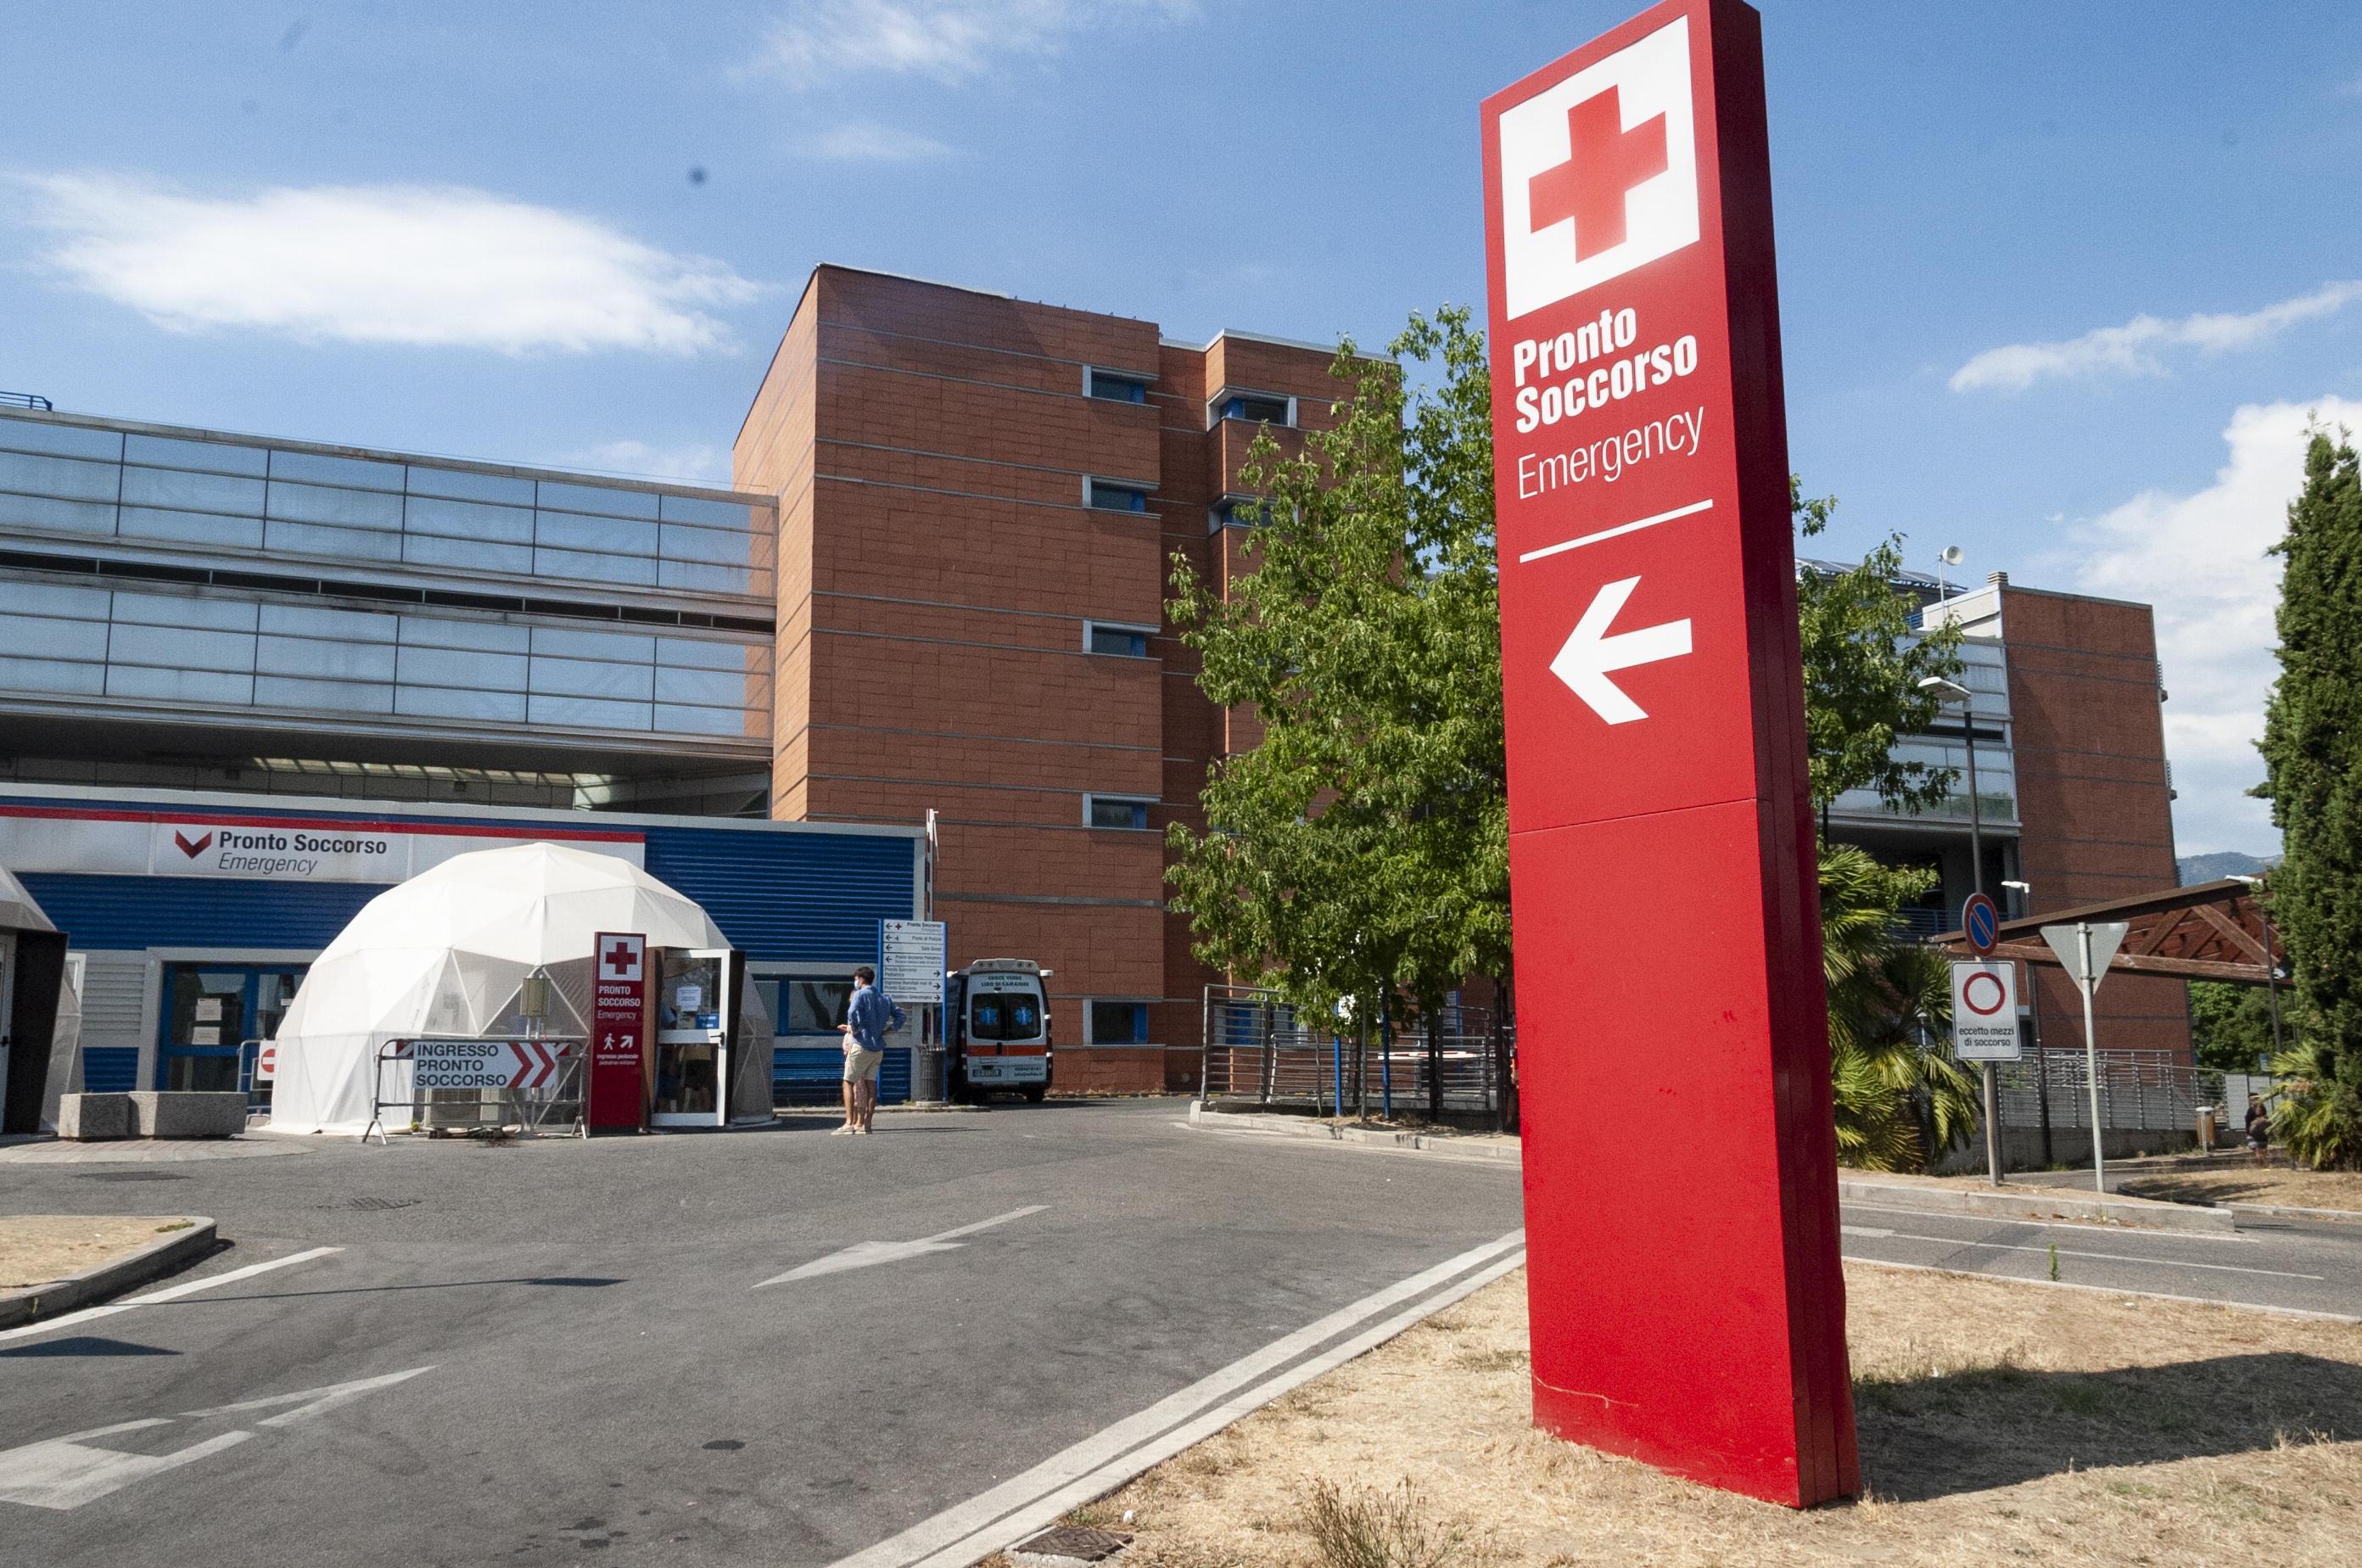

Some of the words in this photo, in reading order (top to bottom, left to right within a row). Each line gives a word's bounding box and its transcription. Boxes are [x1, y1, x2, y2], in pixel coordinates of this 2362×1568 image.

[1513, 307, 1637, 388] Pronto
[1515, 334, 1698, 434] Soccorso
[1518, 406, 1704, 500] Emergency
[219, 831, 288, 850] Pronto
[294, 833, 387, 854] Soccorso
[218, 852, 318, 876] Emergency
[598, 985, 631, 995] PRONTO
[597, 997, 641, 1007] SOCCORSO
[597, 1010, 636, 1021] Emergency
[1958, 1027, 1989, 1035] eccetto
[1990, 1026, 2015, 1035] mezzi
[1964, 1037, 1972, 1046] di
[417, 1044, 499, 1056] INGRESSO
[417, 1060, 484, 1072] PRONTO
[416, 1074, 507, 1086] SOCCORSO
